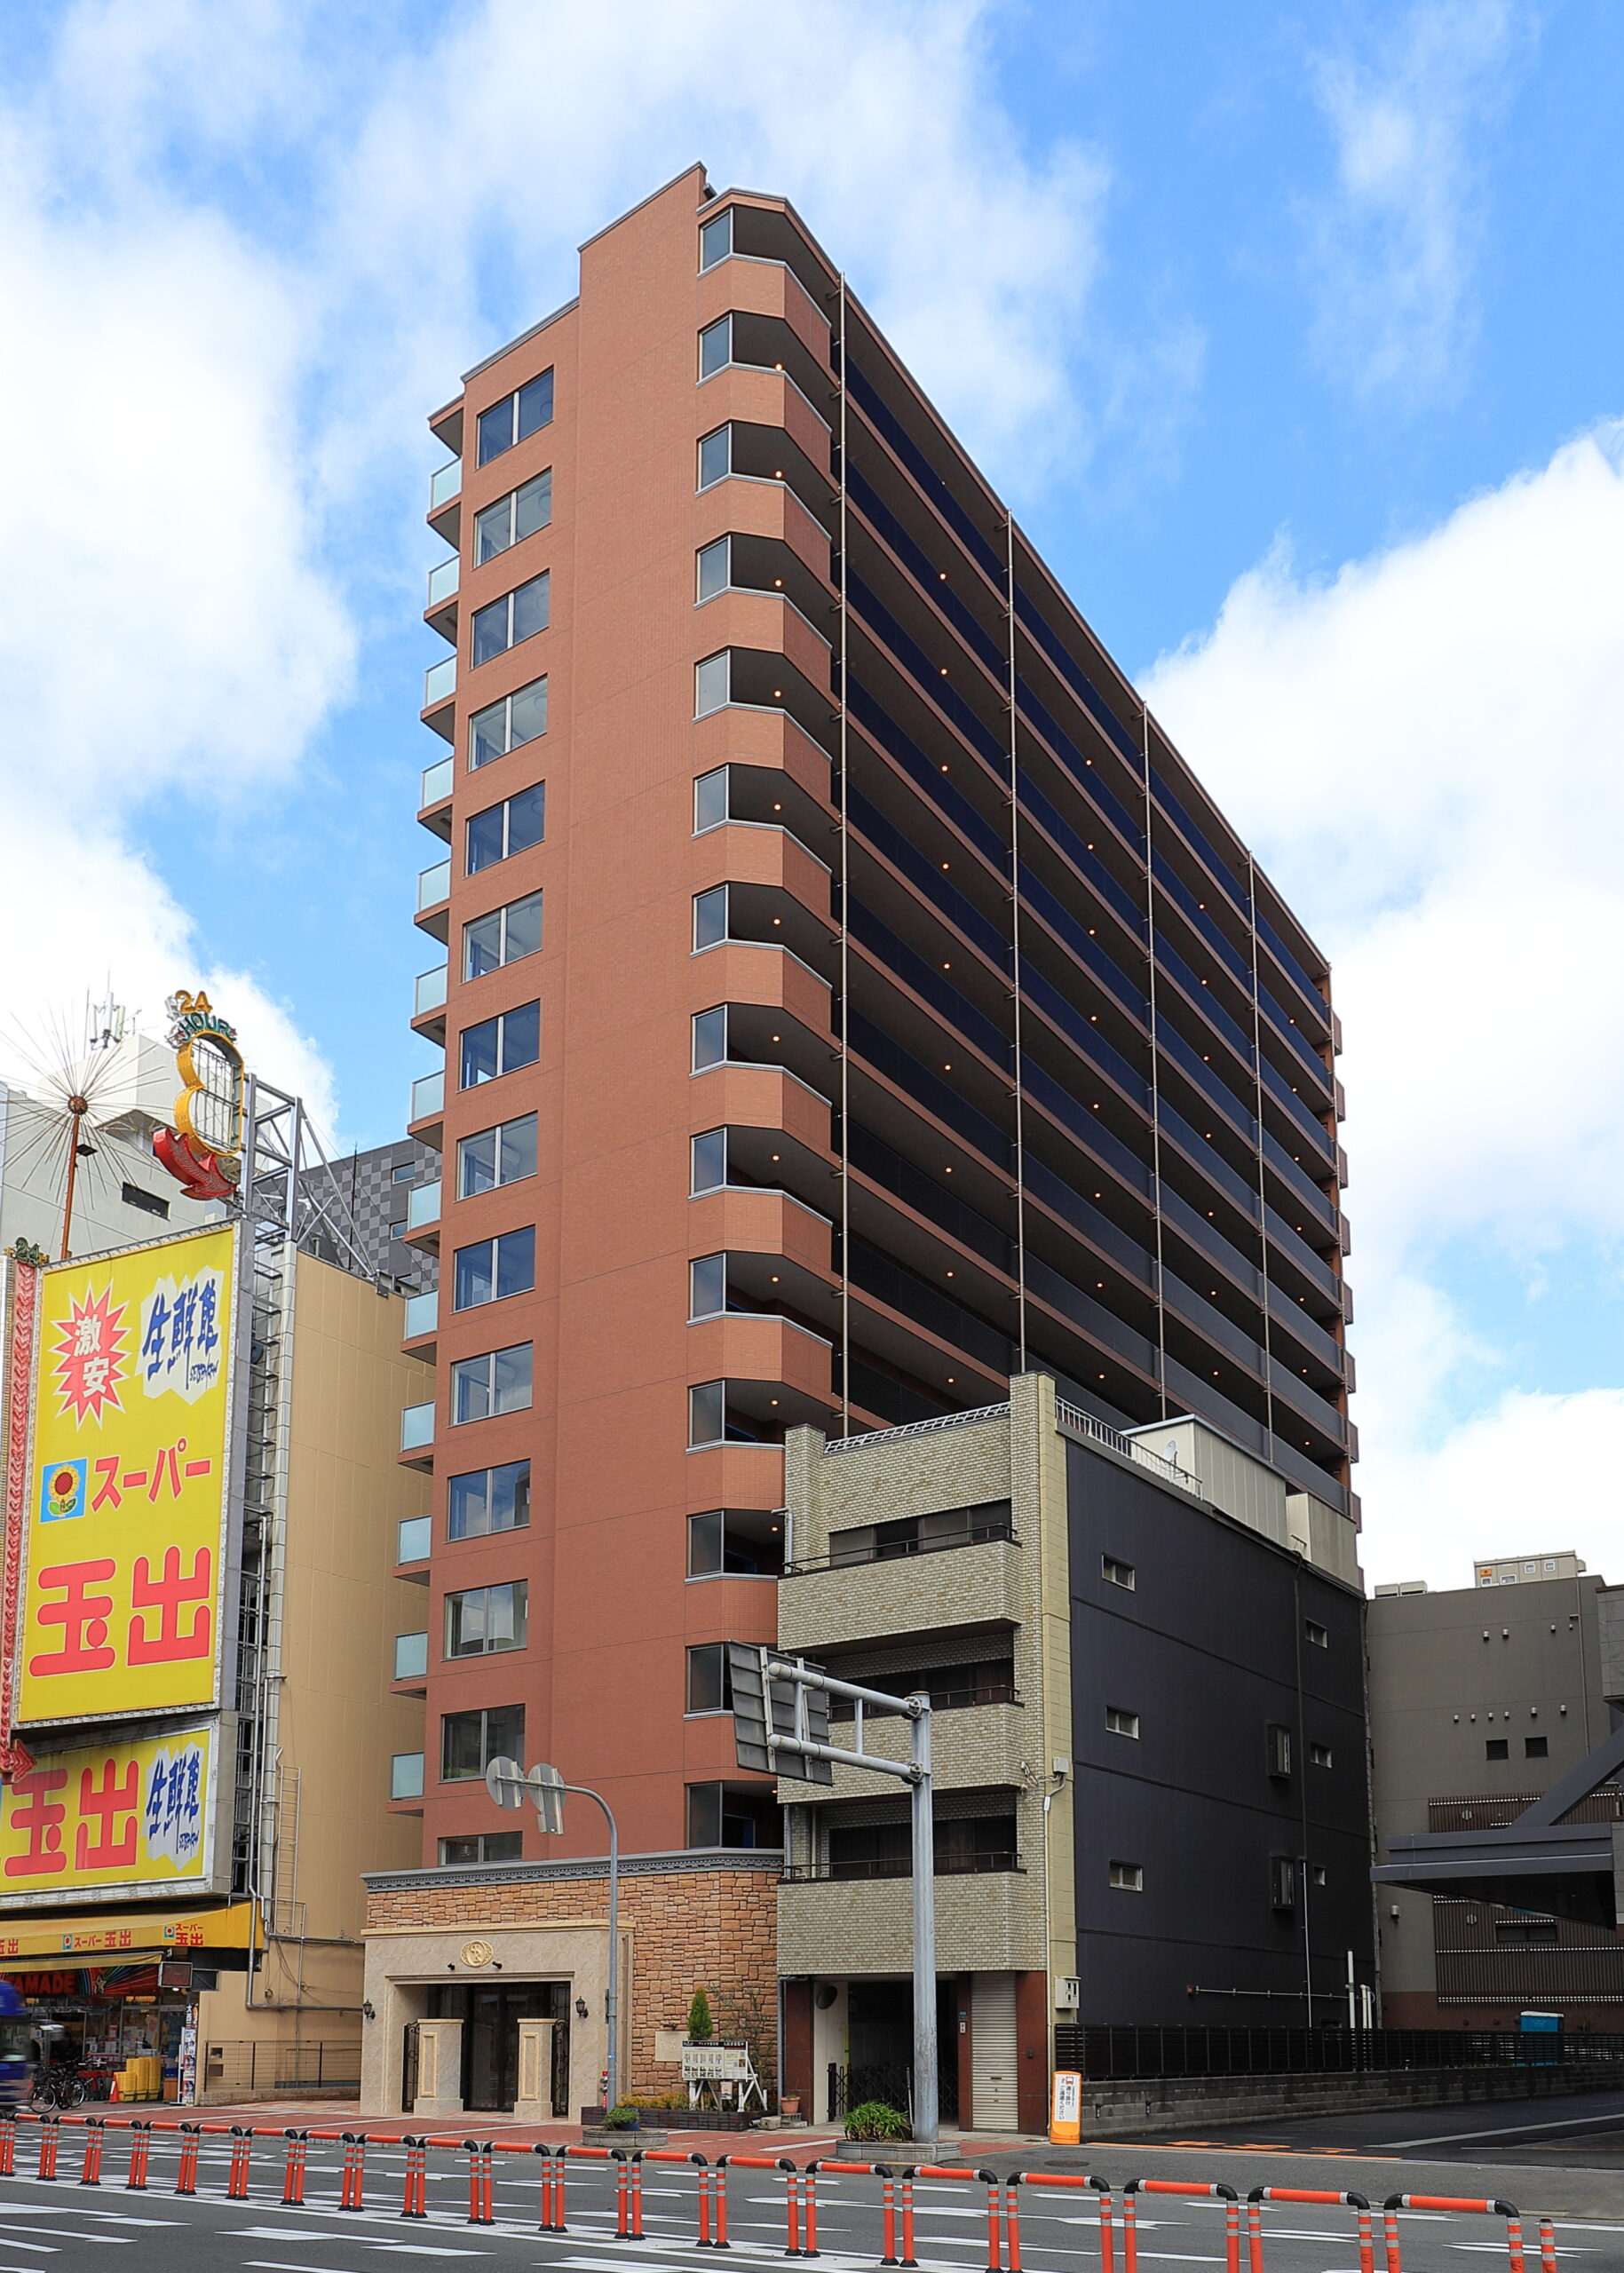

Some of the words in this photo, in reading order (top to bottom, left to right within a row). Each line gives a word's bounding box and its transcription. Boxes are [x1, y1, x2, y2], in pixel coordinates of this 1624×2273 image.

[175, 989, 213, 1014] 24
[15, 1237, 39, 1267] 24
[75, 1315, 109, 1398] 激安
[91, 1437, 210, 1512] スーパー
[29, 1546, 211, 1676] 玉出
[4, 1758, 139, 1877] 玉出
[175, 1932, 203, 1946] 玉出
